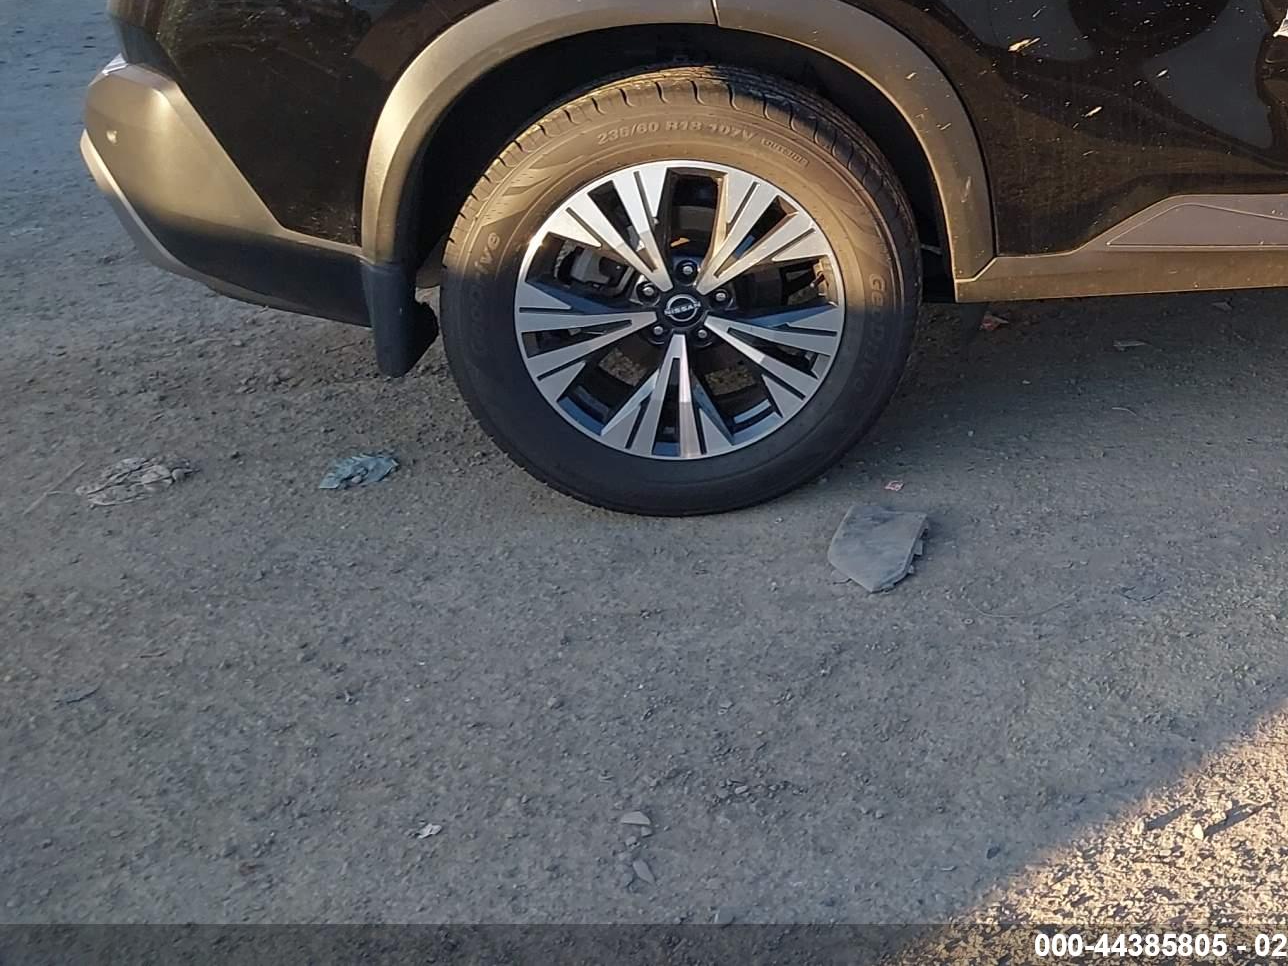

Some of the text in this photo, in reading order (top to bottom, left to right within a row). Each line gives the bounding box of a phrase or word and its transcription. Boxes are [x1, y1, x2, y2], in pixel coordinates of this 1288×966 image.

[596, 121, 660, 146] 235/60
[665, 120, 703, 131] R18
[664, 301, 701, 315] NISSAN
